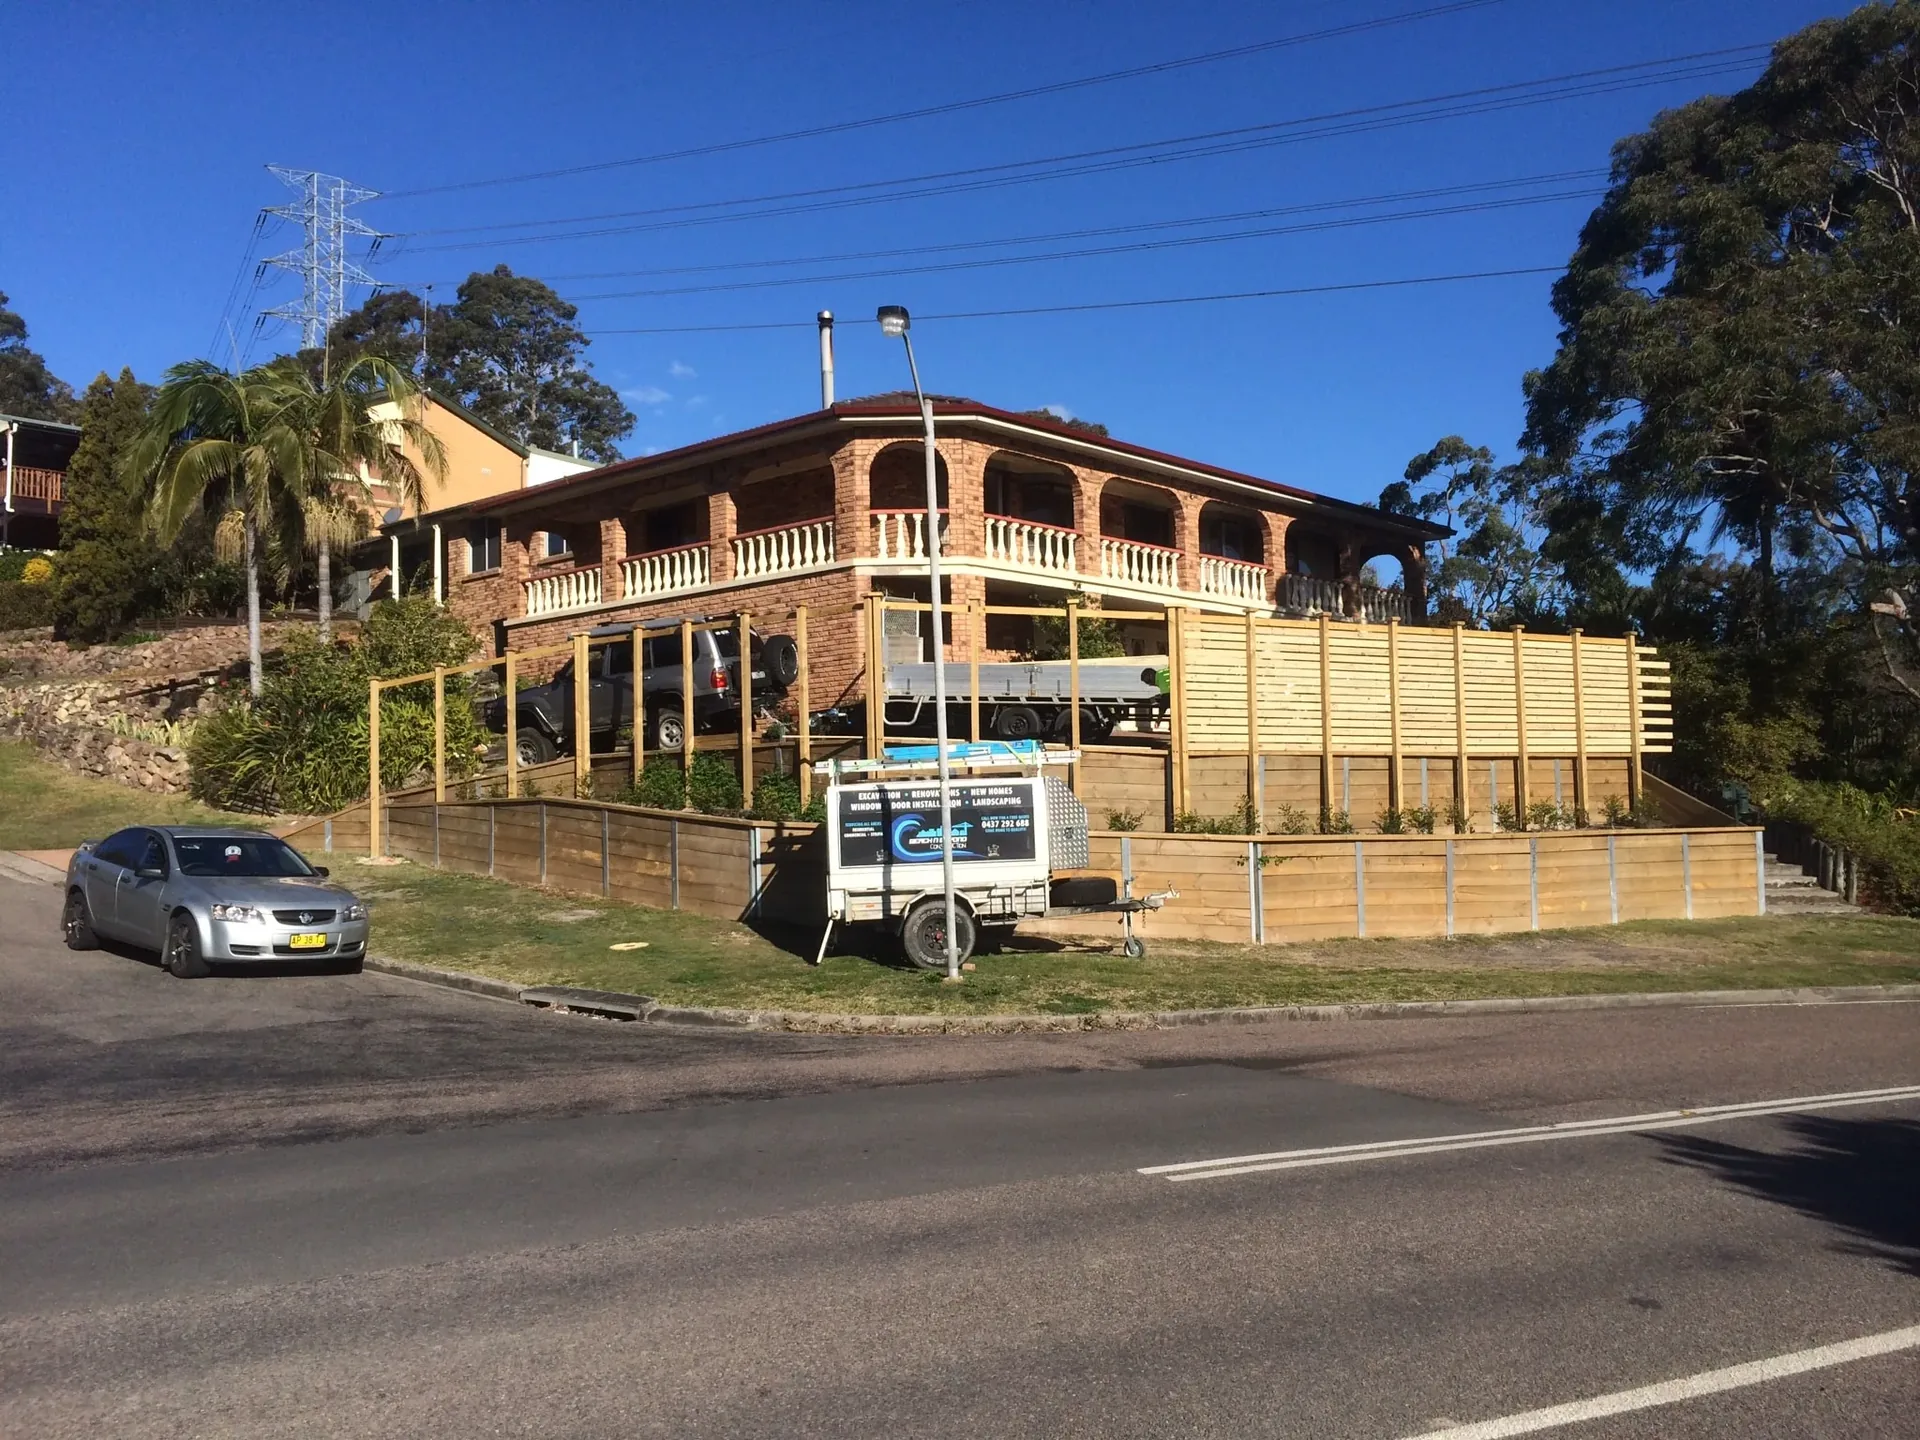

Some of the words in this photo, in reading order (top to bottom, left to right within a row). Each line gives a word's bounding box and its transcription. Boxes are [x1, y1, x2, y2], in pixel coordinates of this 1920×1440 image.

[859, 791, 901, 800] EXCAVATION
[912, 789, 960, 798] RENOVANS
[971, 788, 987, 796] NEW
[989, 787, 1013, 795] HOMES
[891, 801, 911, 809] DOOR
[973, 797, 1022, 806] LANDSCAPING
[981, 820, 999, 829] 0437
[1001, 820, 1015, 828] 292
[1015, 819, 1030, 827] 688
[304, 936, 313, 944] 38
